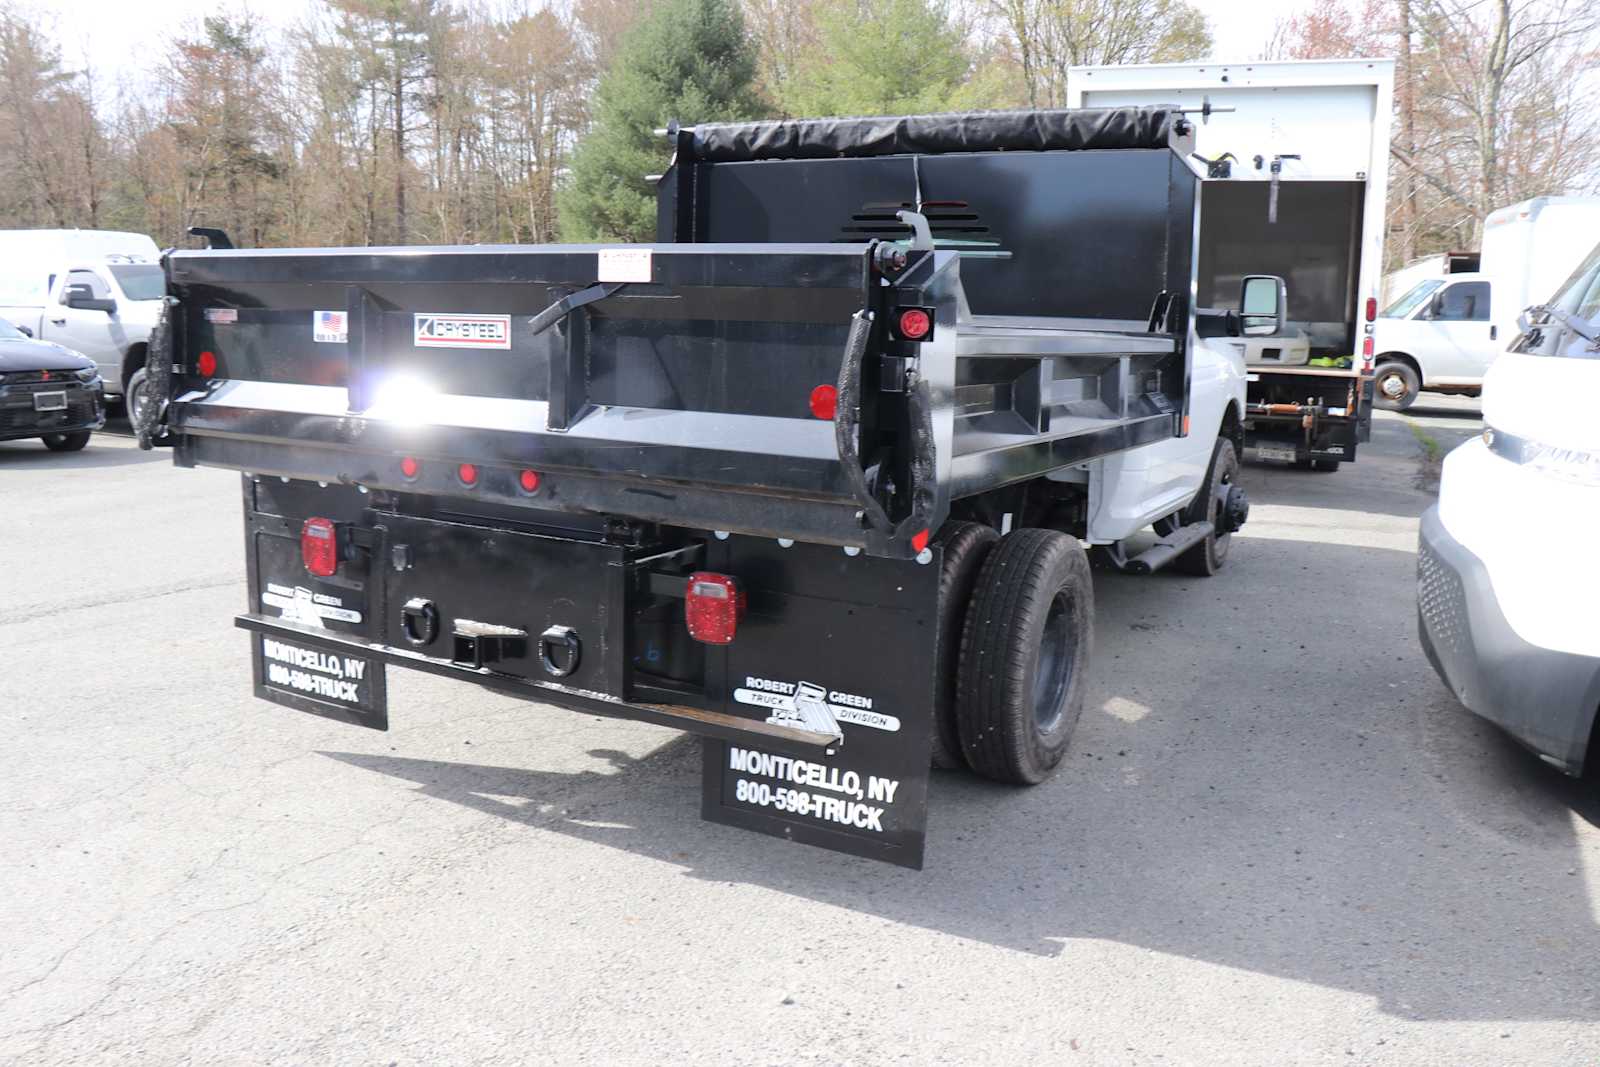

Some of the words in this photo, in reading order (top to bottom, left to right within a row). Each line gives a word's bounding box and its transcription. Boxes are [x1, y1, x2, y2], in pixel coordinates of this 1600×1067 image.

[436, 322, 503, 338] CRYSTEEL
[263, 638, 344, 679] MONTICELLO,
[344, 658, 366, 680] NY
[746, 676, 795, 695] ROBERT
[829, 690, 872, 709] GREEN
[751, 693, 784, 707] TRUCK
[839, 709, 888, 727] DIVISION
[730, 747, 864, 801] MONTICELLO,
[867, 775, 899, 804] NY
[736, 779, 885, 832] 800-598-TRUCK
